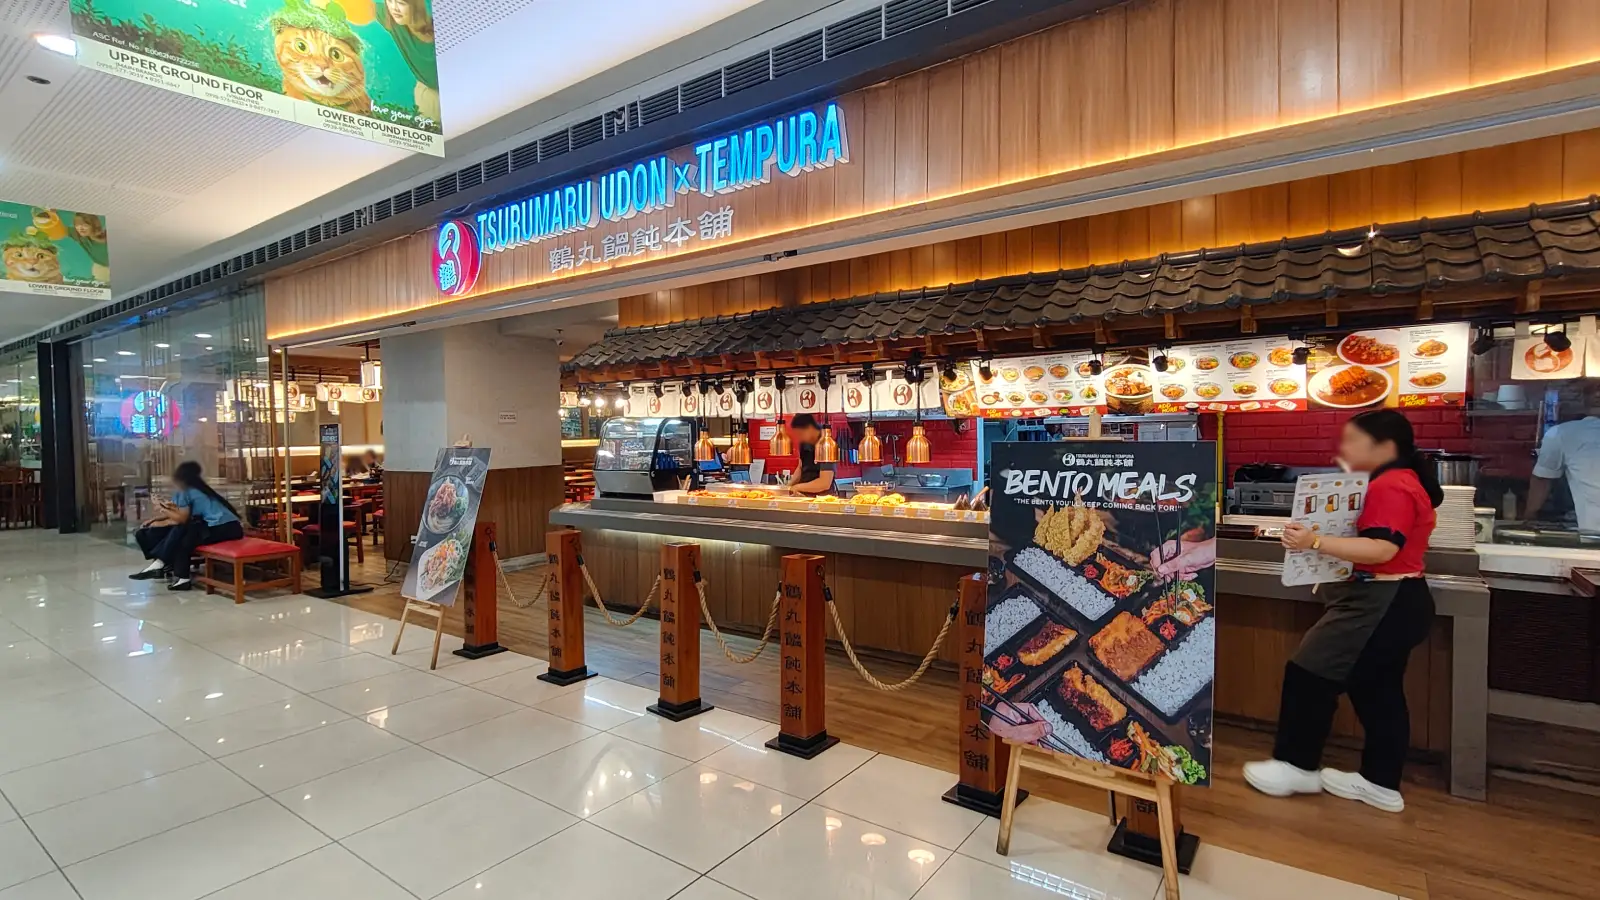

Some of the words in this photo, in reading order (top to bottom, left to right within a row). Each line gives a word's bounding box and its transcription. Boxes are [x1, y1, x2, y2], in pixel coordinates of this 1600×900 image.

[92, 31, 110, 41] ASC
[109, 49, 158, 72] UPPER
[161, 65, 220, 89] GROUND
[223, 82, 264, 101] FLOOR
[370, 100, 389, 115] love
[390, 109, 412, 121] your
[317, 107, 356, 125] LOWER
[357, 117, 401, 136] GROUND
[402, 129, 434, 143] FLOOR
[477, 179, 597, 253] TSURUMARU
[601, 156, 672, 221] UDON
[696, 103, 846, 197] TEMPURA
[1400, 394, 1418, 403] ADD
[1404, 398, 1427, 407] MORE
[1003, 469, 1093, 499] BENTO
[1097, 471, 1197, 503] MEALS
[1031, 498, 1054, 506] BENTO
[1102, 501, 1134, 510] COMING
[1135, 503, 1156, 511] BACK
